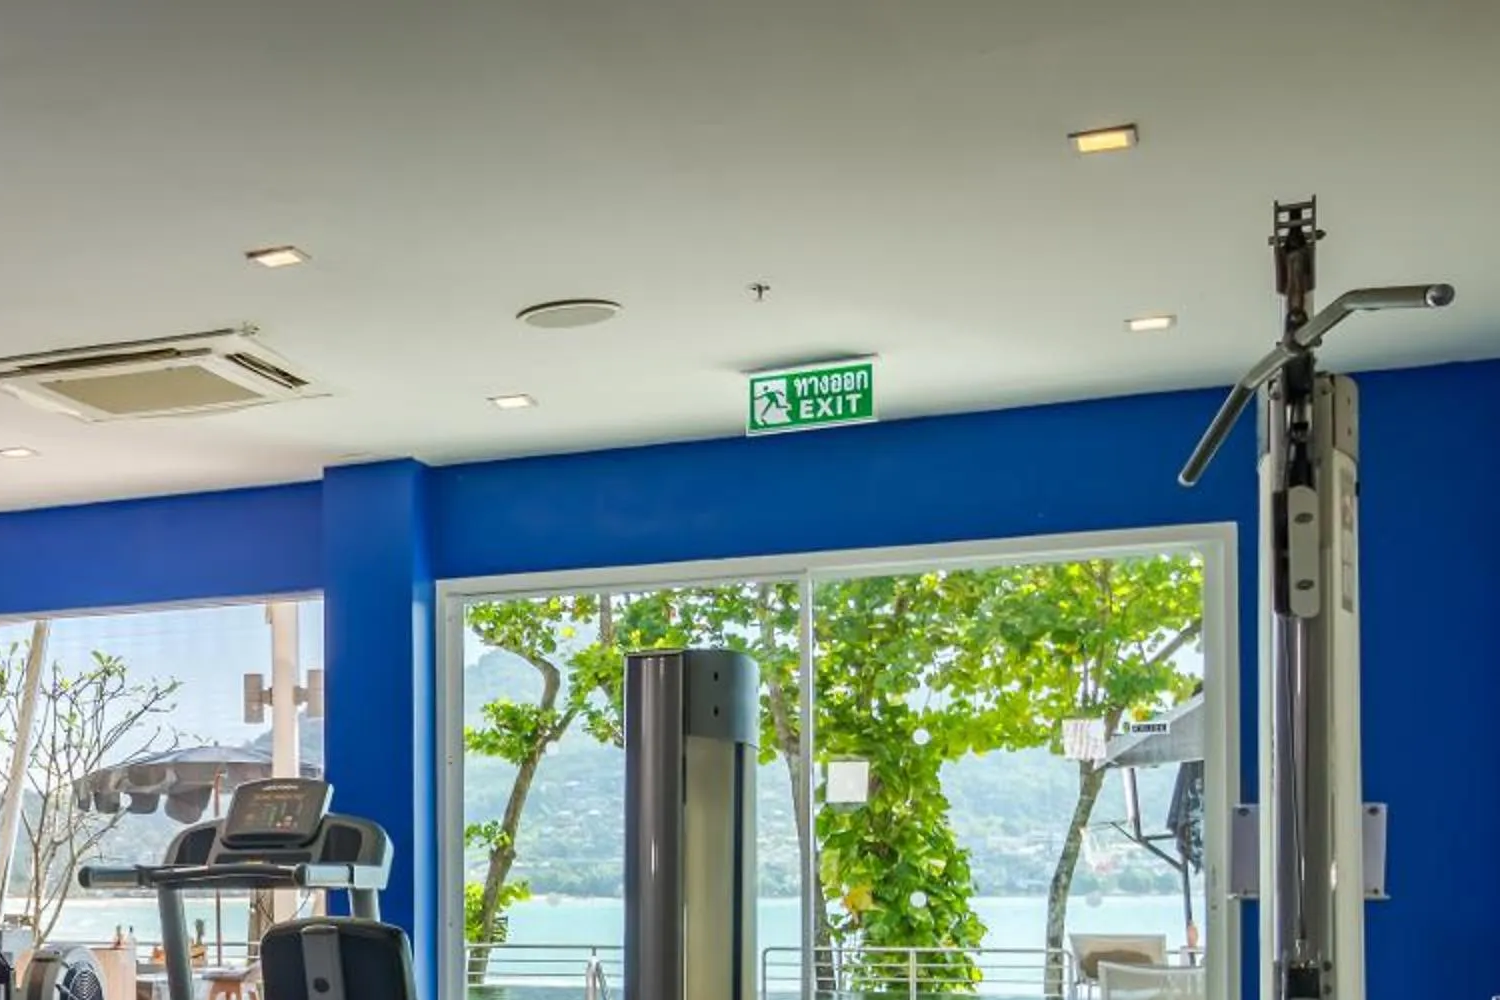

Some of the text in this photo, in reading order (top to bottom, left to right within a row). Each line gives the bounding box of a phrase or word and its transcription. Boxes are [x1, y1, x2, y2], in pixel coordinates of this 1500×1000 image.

[793, 370, 869, 397] ทางออก
[800, 394, 862, 420] EXIT
